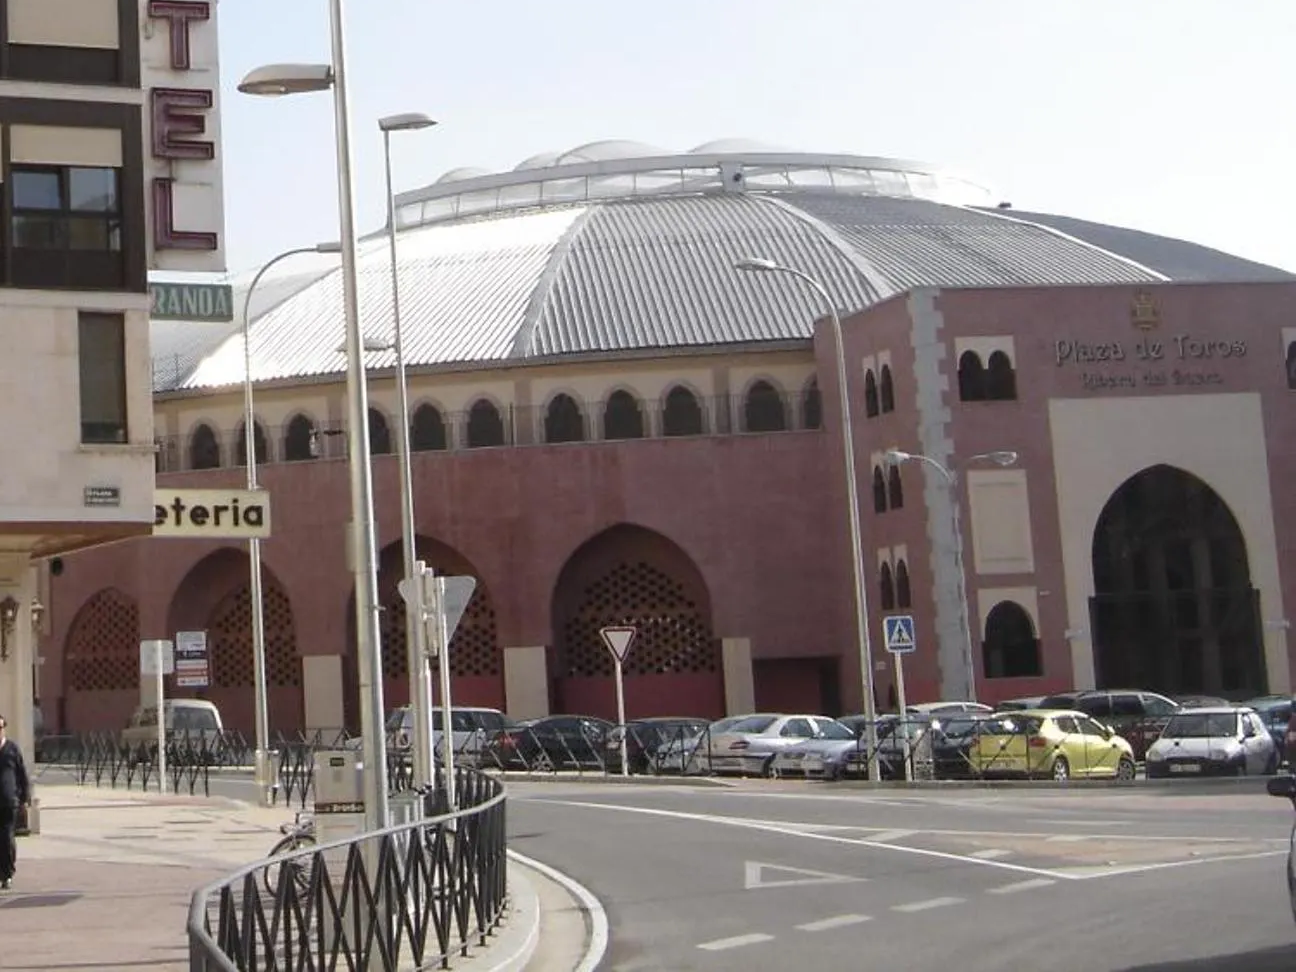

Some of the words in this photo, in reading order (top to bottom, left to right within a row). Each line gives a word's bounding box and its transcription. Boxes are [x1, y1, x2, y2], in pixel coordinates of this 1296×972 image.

[1055, 338, 1126, 367] Plaza
[1136, 332, 1165, 360] de
[1173, 333, 1248, 360] Toros
[155, 496, 264, 527] eteria
